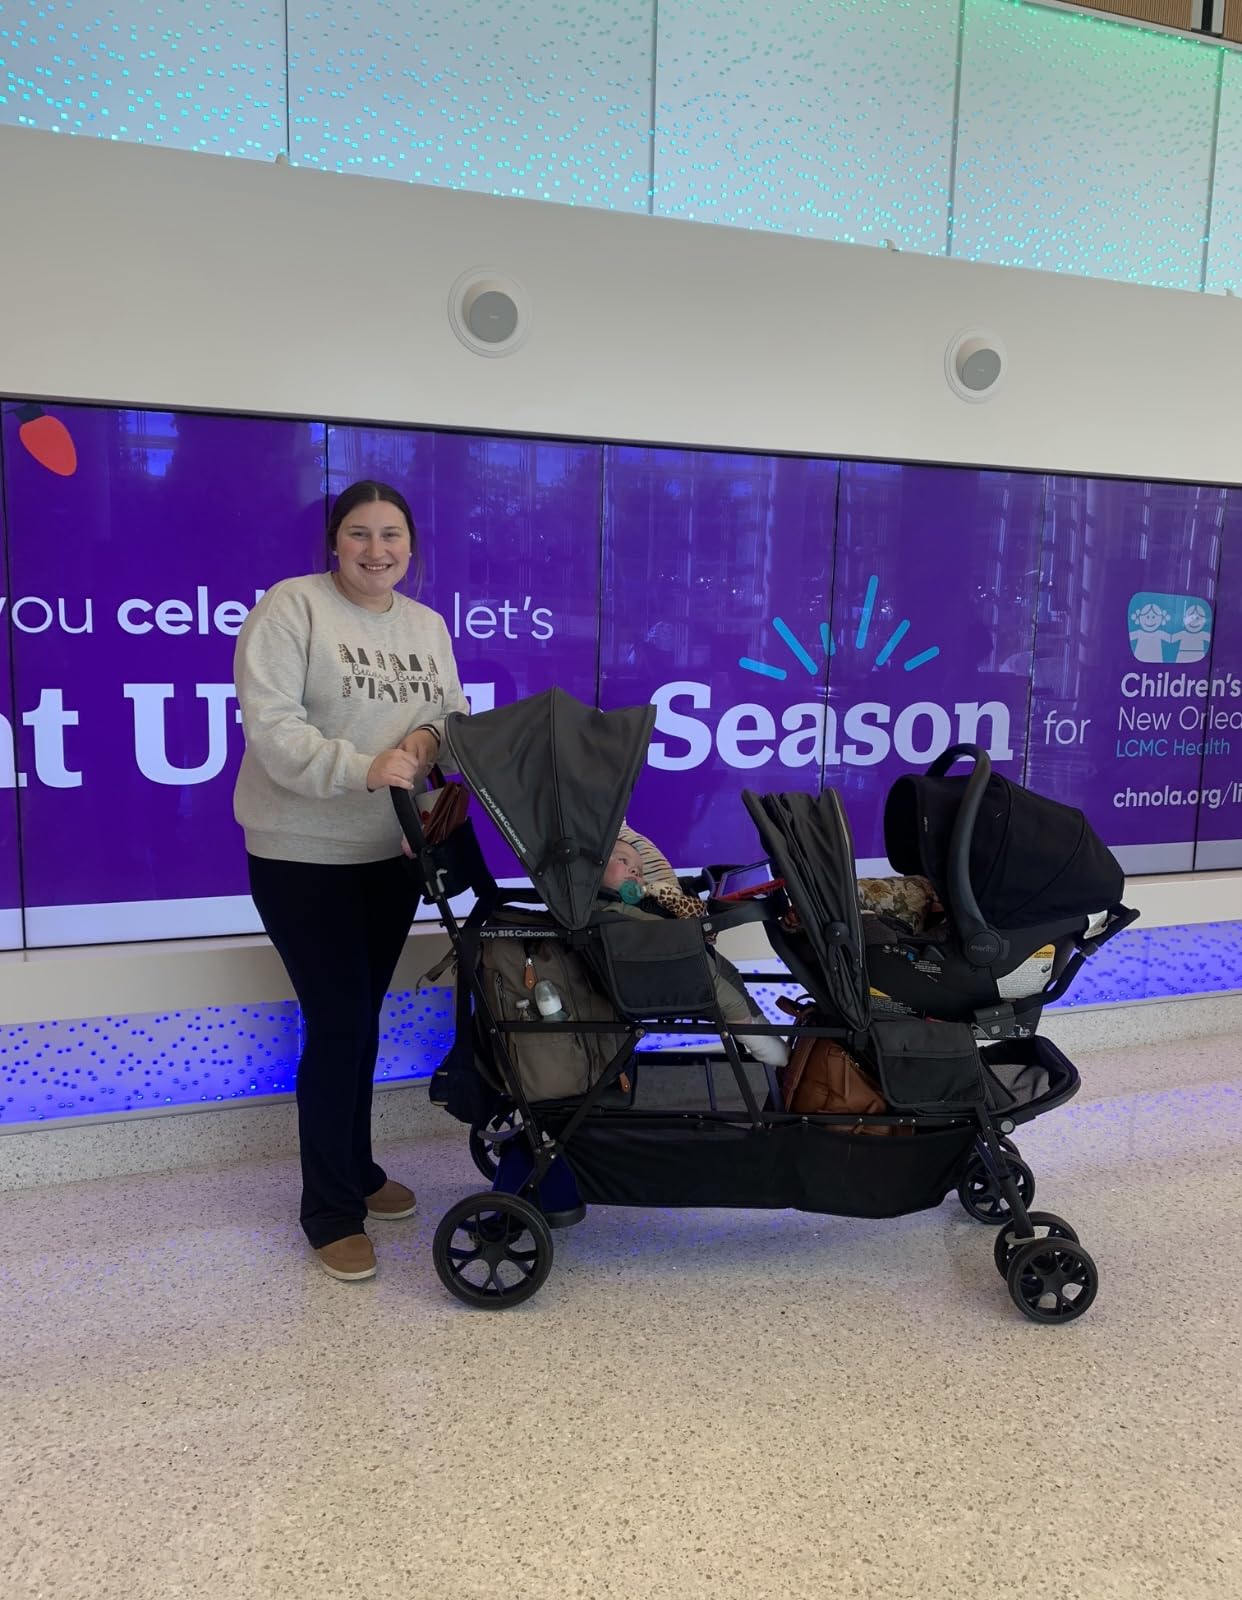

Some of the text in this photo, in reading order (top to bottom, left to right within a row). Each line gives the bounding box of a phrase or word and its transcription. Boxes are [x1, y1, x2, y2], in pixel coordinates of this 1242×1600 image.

[0, 585, 554, 640] ou cele let's
[1121, 672, 1241, 698] Children's
[1118, 706, 1172, 731] New
[123, 683, 243, 785] U
[647, 681, 1014, 771] Season
[1043, 710, 1091, 744] for
[1116, 738, 1230, 757] LCMC Health
